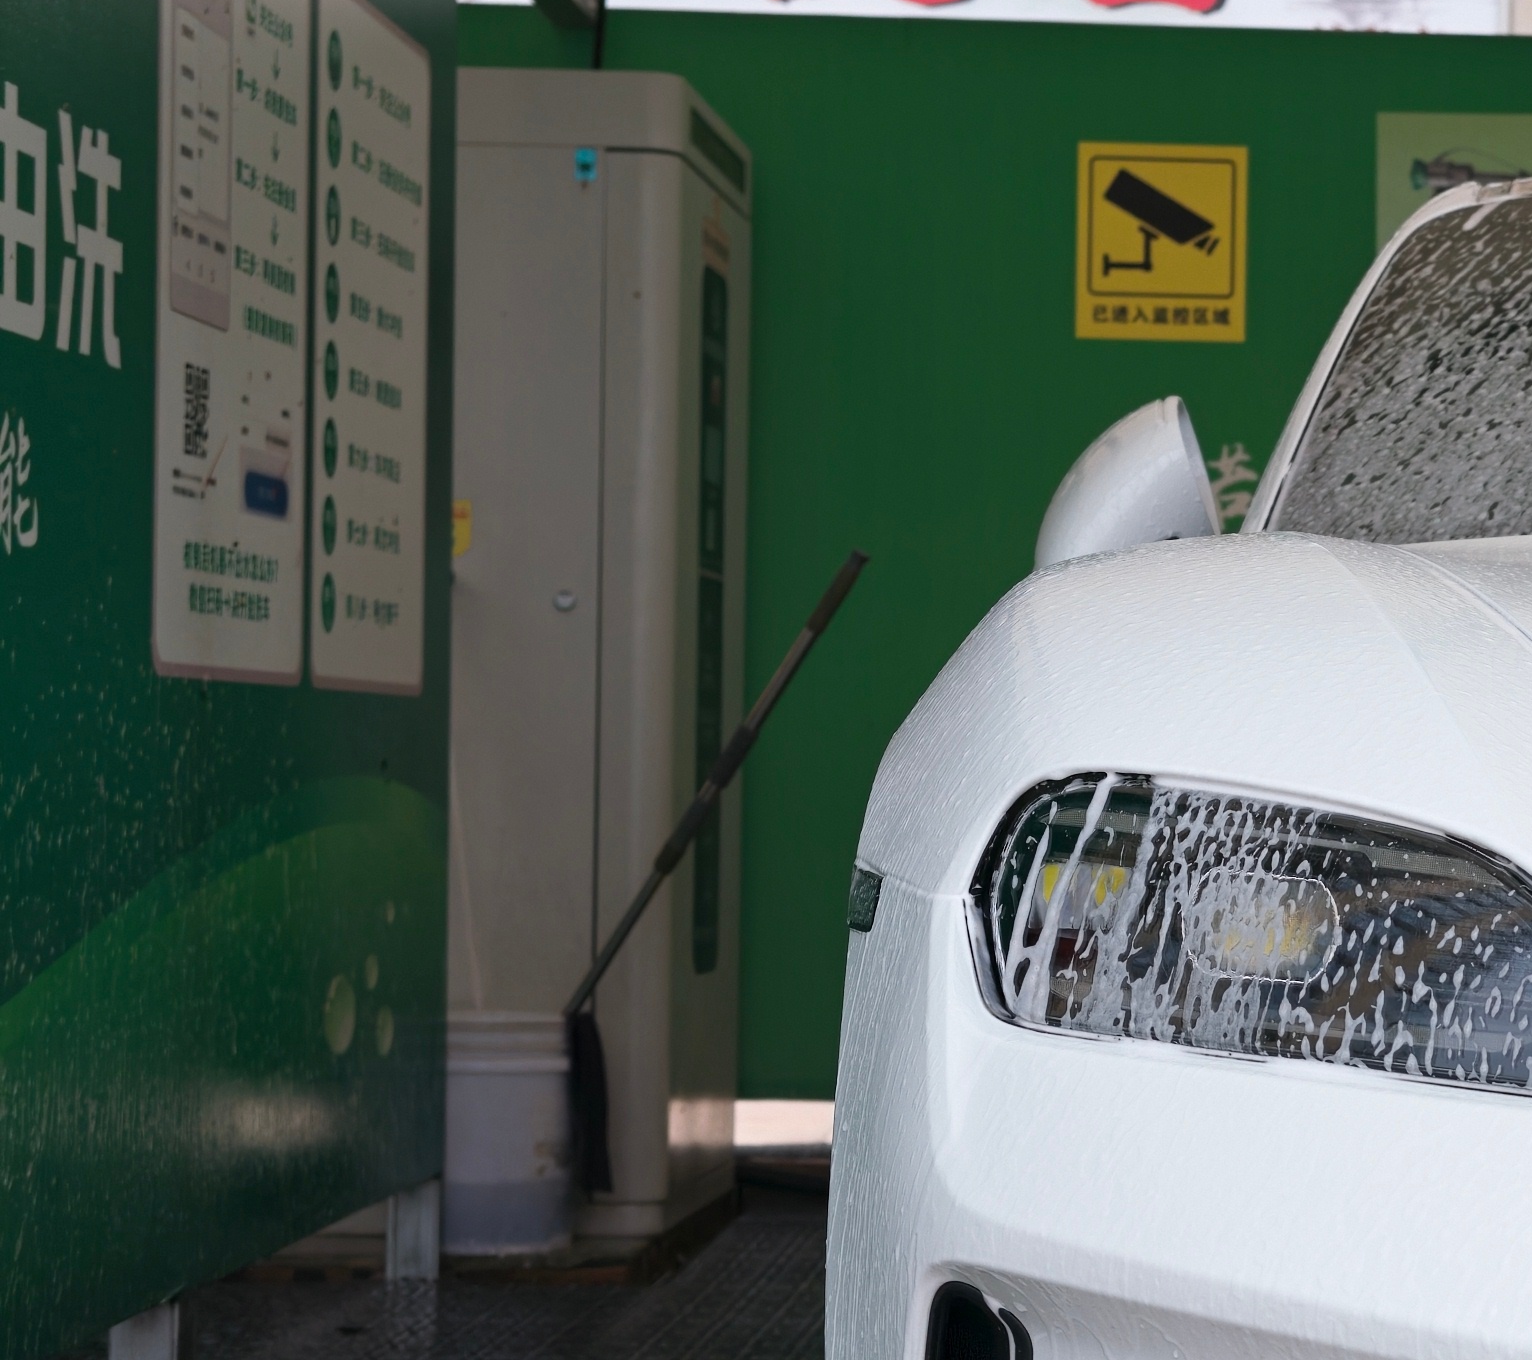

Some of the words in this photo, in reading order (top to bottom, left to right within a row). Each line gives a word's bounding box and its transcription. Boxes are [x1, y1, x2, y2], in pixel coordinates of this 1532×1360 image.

[1092, 305, 1231, 326] 已进入监控区域
